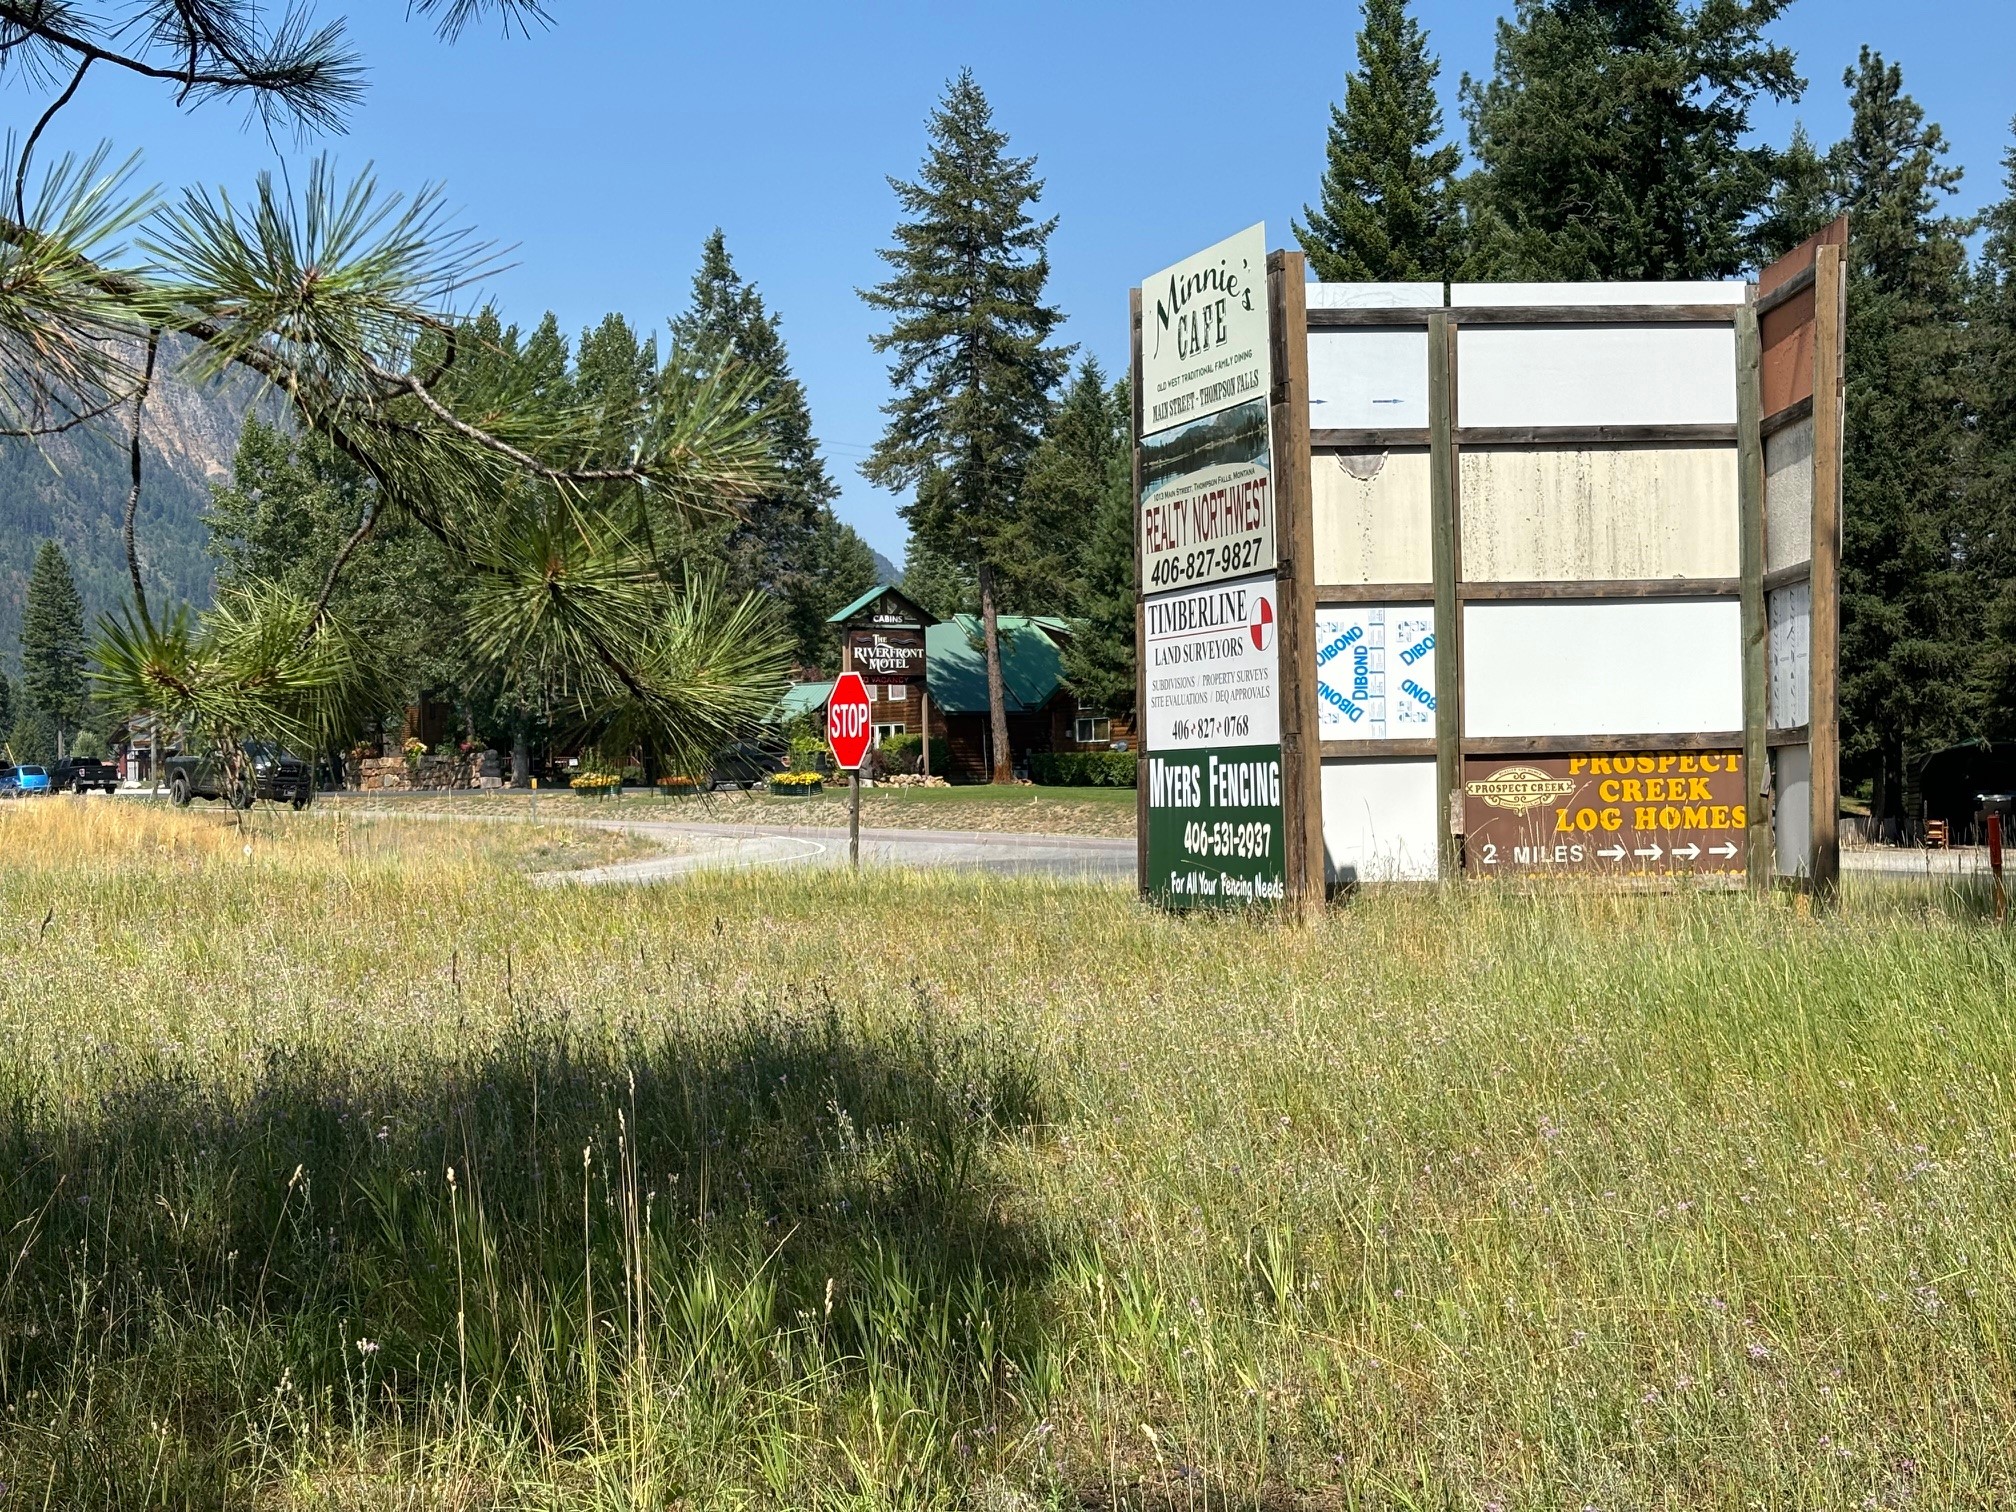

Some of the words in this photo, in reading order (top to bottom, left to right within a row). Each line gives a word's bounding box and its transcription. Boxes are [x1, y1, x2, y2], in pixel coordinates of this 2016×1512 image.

[1153, 258, 1255, 360] Minnie's
[1177, 297, 1228, 361] CAFE
[1157, 381, 1167, 392] OLD
[1168, 376, 1180, 388] WEST
[1181, 364, 1214, 383] TRADITIONAL
[1214, 356, 1234, 371] FAMILY
[1234, 349, 1253, 364] DINING
[1152, 401, 1169, 423] MAIN
[1169, 391, 1195, 416] STREET
[1199, 376, 1236, 407] THOMPSON
[1236, 368, 1259, 394] FALLS
[1146, 499, 1188, 555] REALTY
[1192, 476, 1267, 544] NORTHWEST
[1151, 537, 1263, 587] 406-827-9827
[873, 614, 903, 623] CABINS
[1148, 589, 1248, 636] TIMBERLINE
[1154, 645, 1181, 666] LAND
[1183, 636, 1243, 663] SURVEYORS
[1399, 633, 1436, 667] DIBO
[871, 676, 909, 684] VACANCY
[1152, 675, 1196, 692] SUBDIVISIONS
[1202, 671, 1236, 687] PROPERTY
[1236, 667, 1269, 683] SURVEYS
[1352, 645, 1368, 700] DIBOND
[1150, 696, 1165, 709] SITE
[1165, 691, 1208, 707] EVALUATIONS
[1215, 689, 1230, 704] DEQ
[1230, 685, 1270, 701] APPROVALS
[831, 703, 868, 739] STOP
[1568, 750, 1744, 775] PROSPECT
[1149, 758, 1201, 808] MYERS
[1209, 755, 1280, 808] FENCING
[1475, 784, 1528, 794] PROSPECT
[1530, 782, 1565, 792] CREEK
[1598, 777, 1713, 803] CREEK
[1555, 806, 1623, 832] LOG
[1633, 804, 1746, 831] HOMES
[1184, 820, 1272, 859] 406-531-2937
[1482, 843, 1498, 864] 2
[1513, 844, 1584, 864] MILES
[1171, 870, 1186, 894] For
[1186, 871, 1198, 895] All
[1198, 870, 1218, 896] Your
[1220, 872, 1252, 904] Fencing
[1255, 871, 1284, 900] Needs
